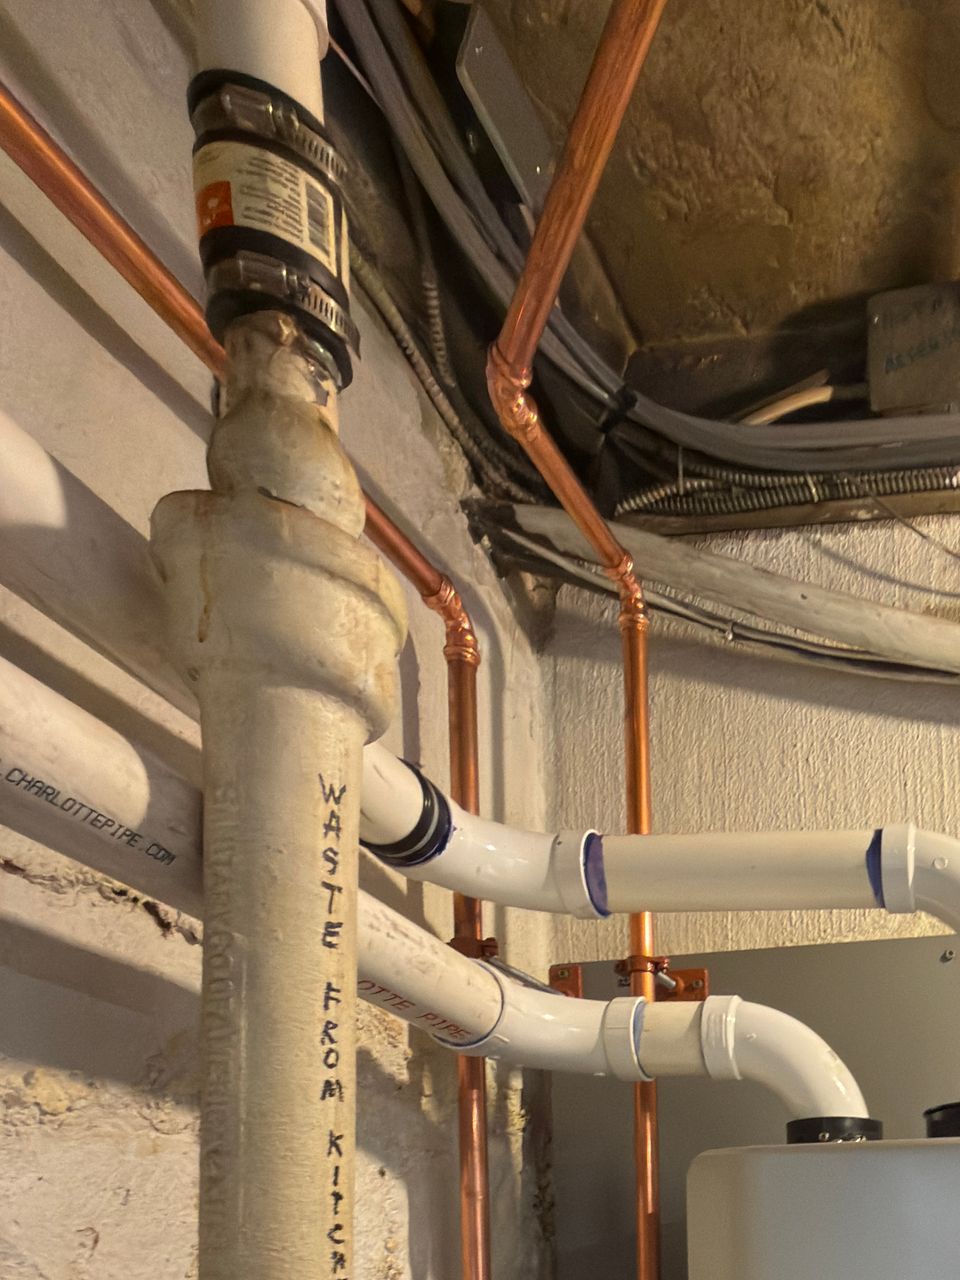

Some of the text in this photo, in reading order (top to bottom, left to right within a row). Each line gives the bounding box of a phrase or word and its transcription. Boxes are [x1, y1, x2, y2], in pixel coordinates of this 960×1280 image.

[317, 772, 347, 950] WASTE
[320, 981, 345, 1102] FROM
[415, 1011, 473, 1040] PIPE
